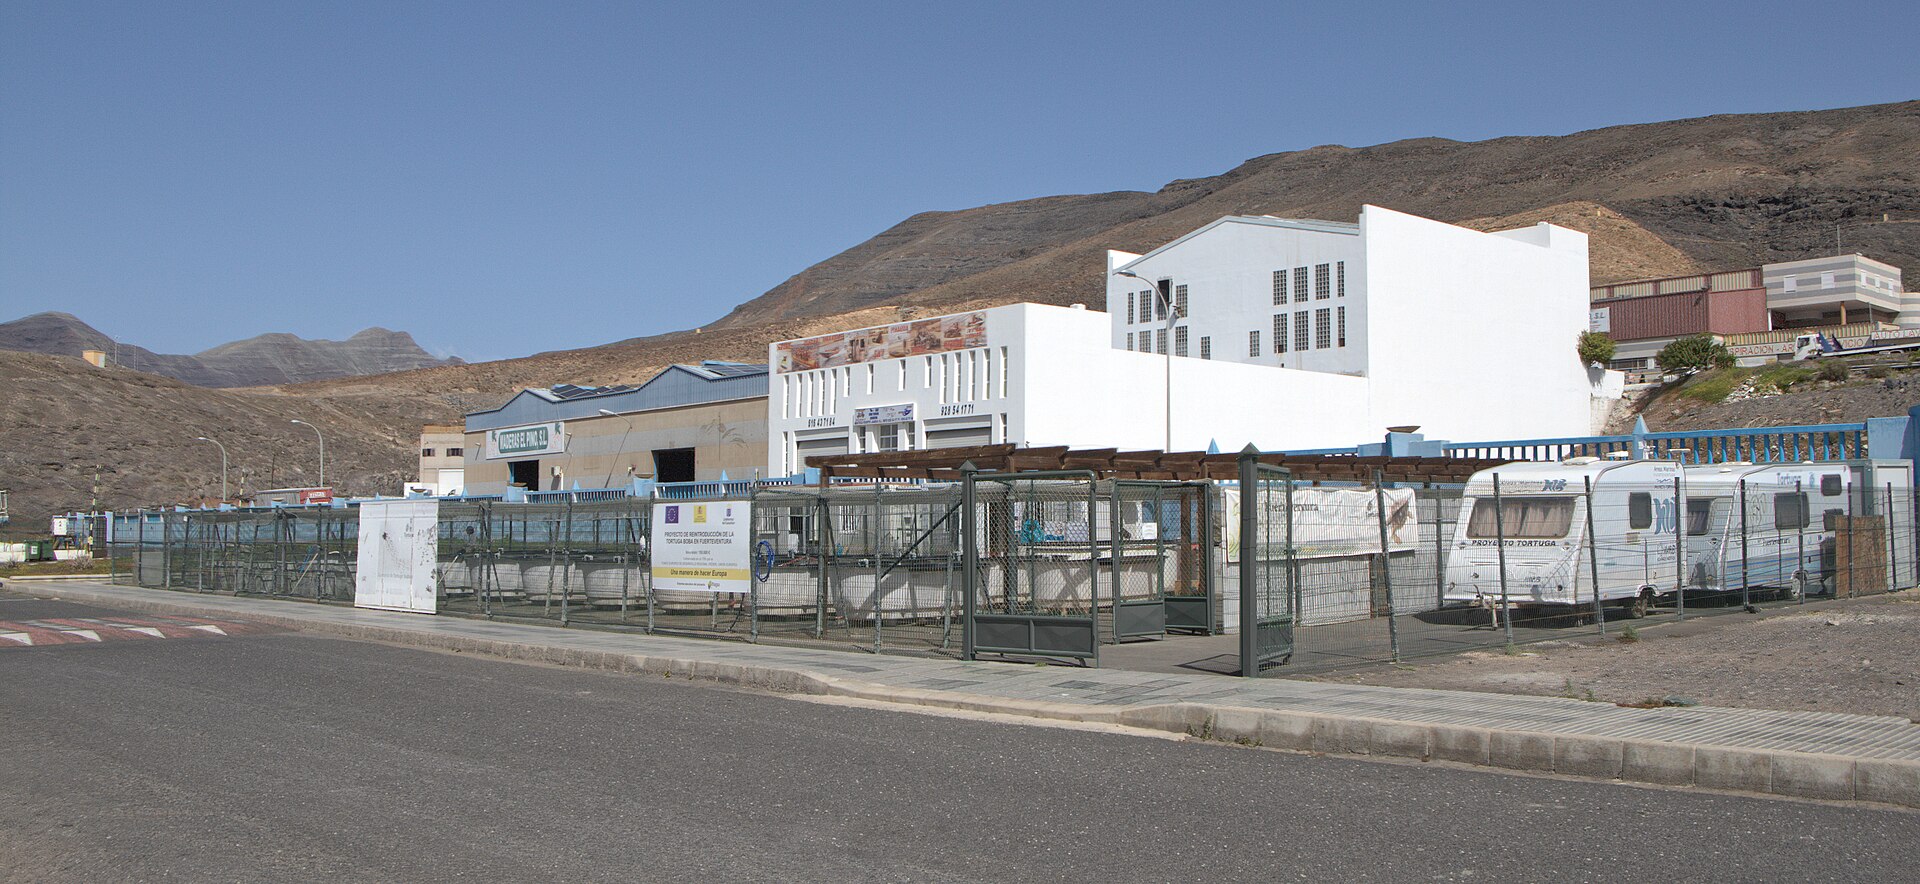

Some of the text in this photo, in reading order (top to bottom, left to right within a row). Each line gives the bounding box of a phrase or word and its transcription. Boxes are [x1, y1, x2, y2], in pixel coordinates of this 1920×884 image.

[1728, 343, 1774, 356] SPIRACION
[1841, 338, 1864, 348] VICIO
[940, 405, 951, 416] 928
[952, 404, 960, 415] 54
[500, 432, 520, 449] MADERAS
[520, 431, 526, 448] EL
